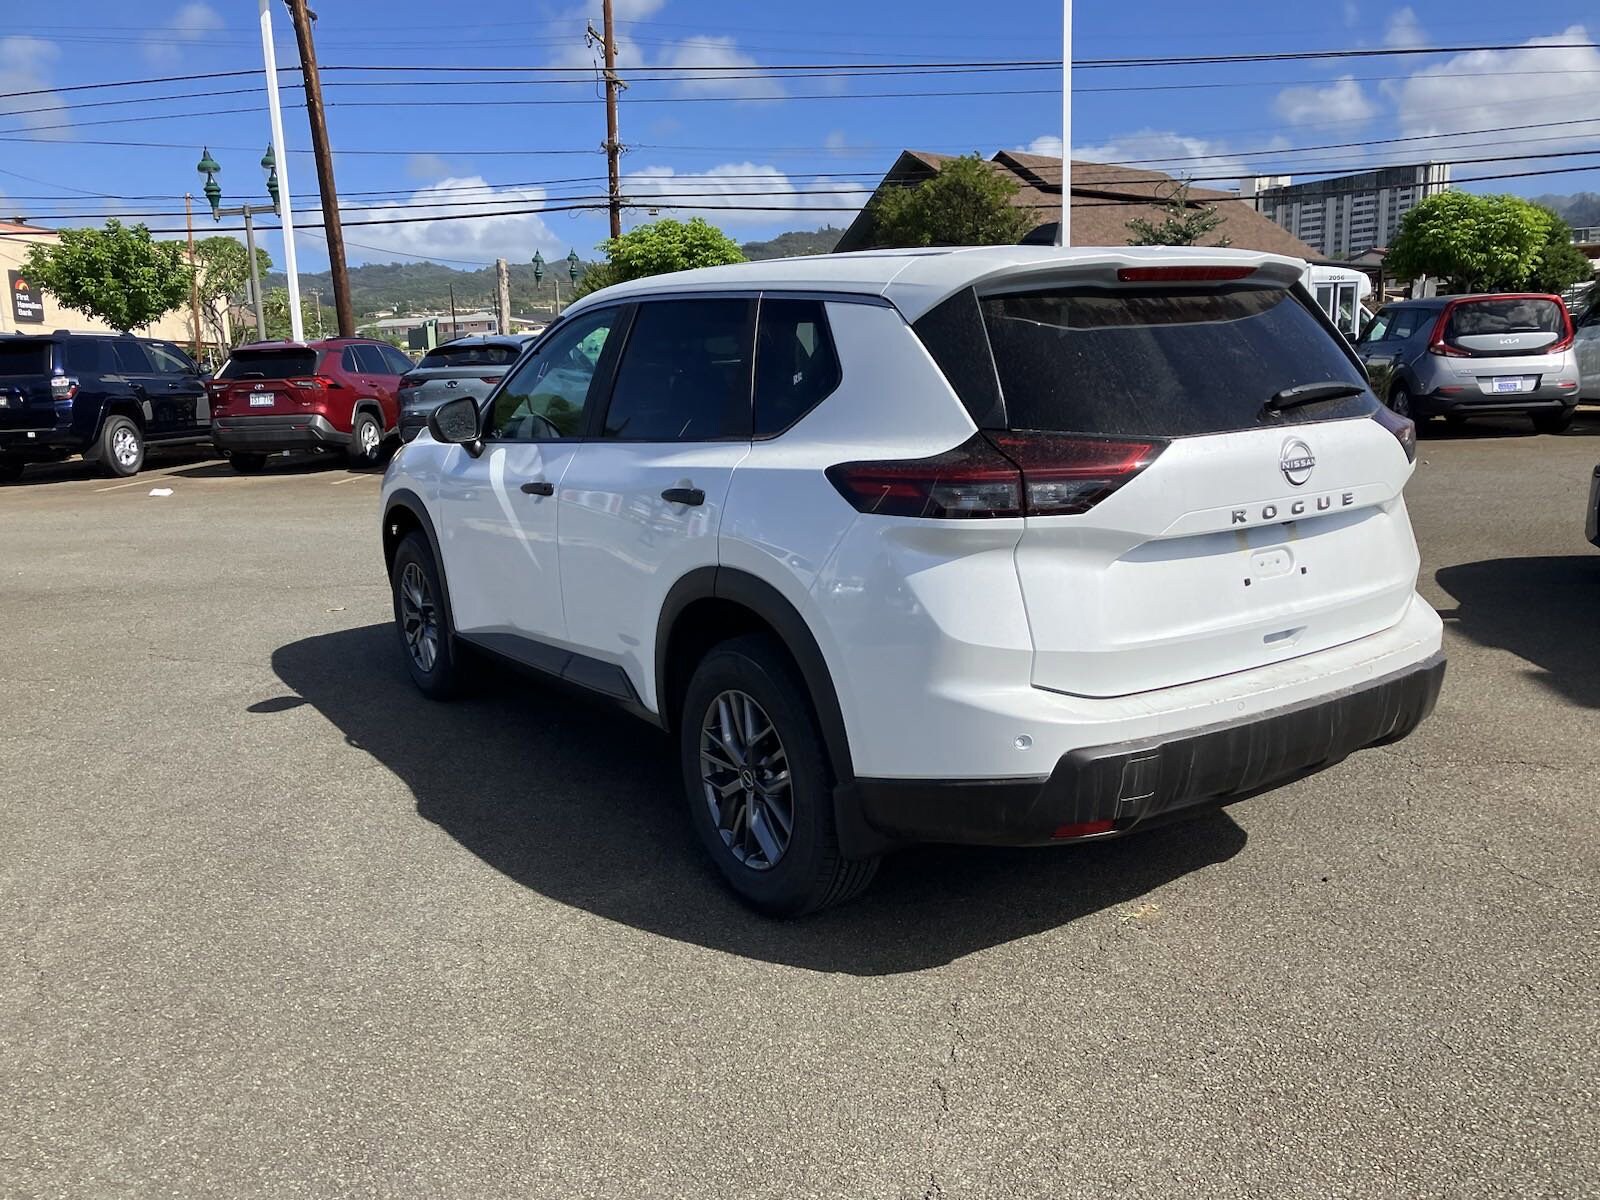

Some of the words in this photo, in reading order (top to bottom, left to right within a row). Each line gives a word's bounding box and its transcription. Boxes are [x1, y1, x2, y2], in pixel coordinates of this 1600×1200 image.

[15, 293, 29, 301] First
[17, 301, 42, 310] Hawaiian
[1282, 458, 1315, 470] NISSAN
[1231, 492, 1354, 524] ROGUE
